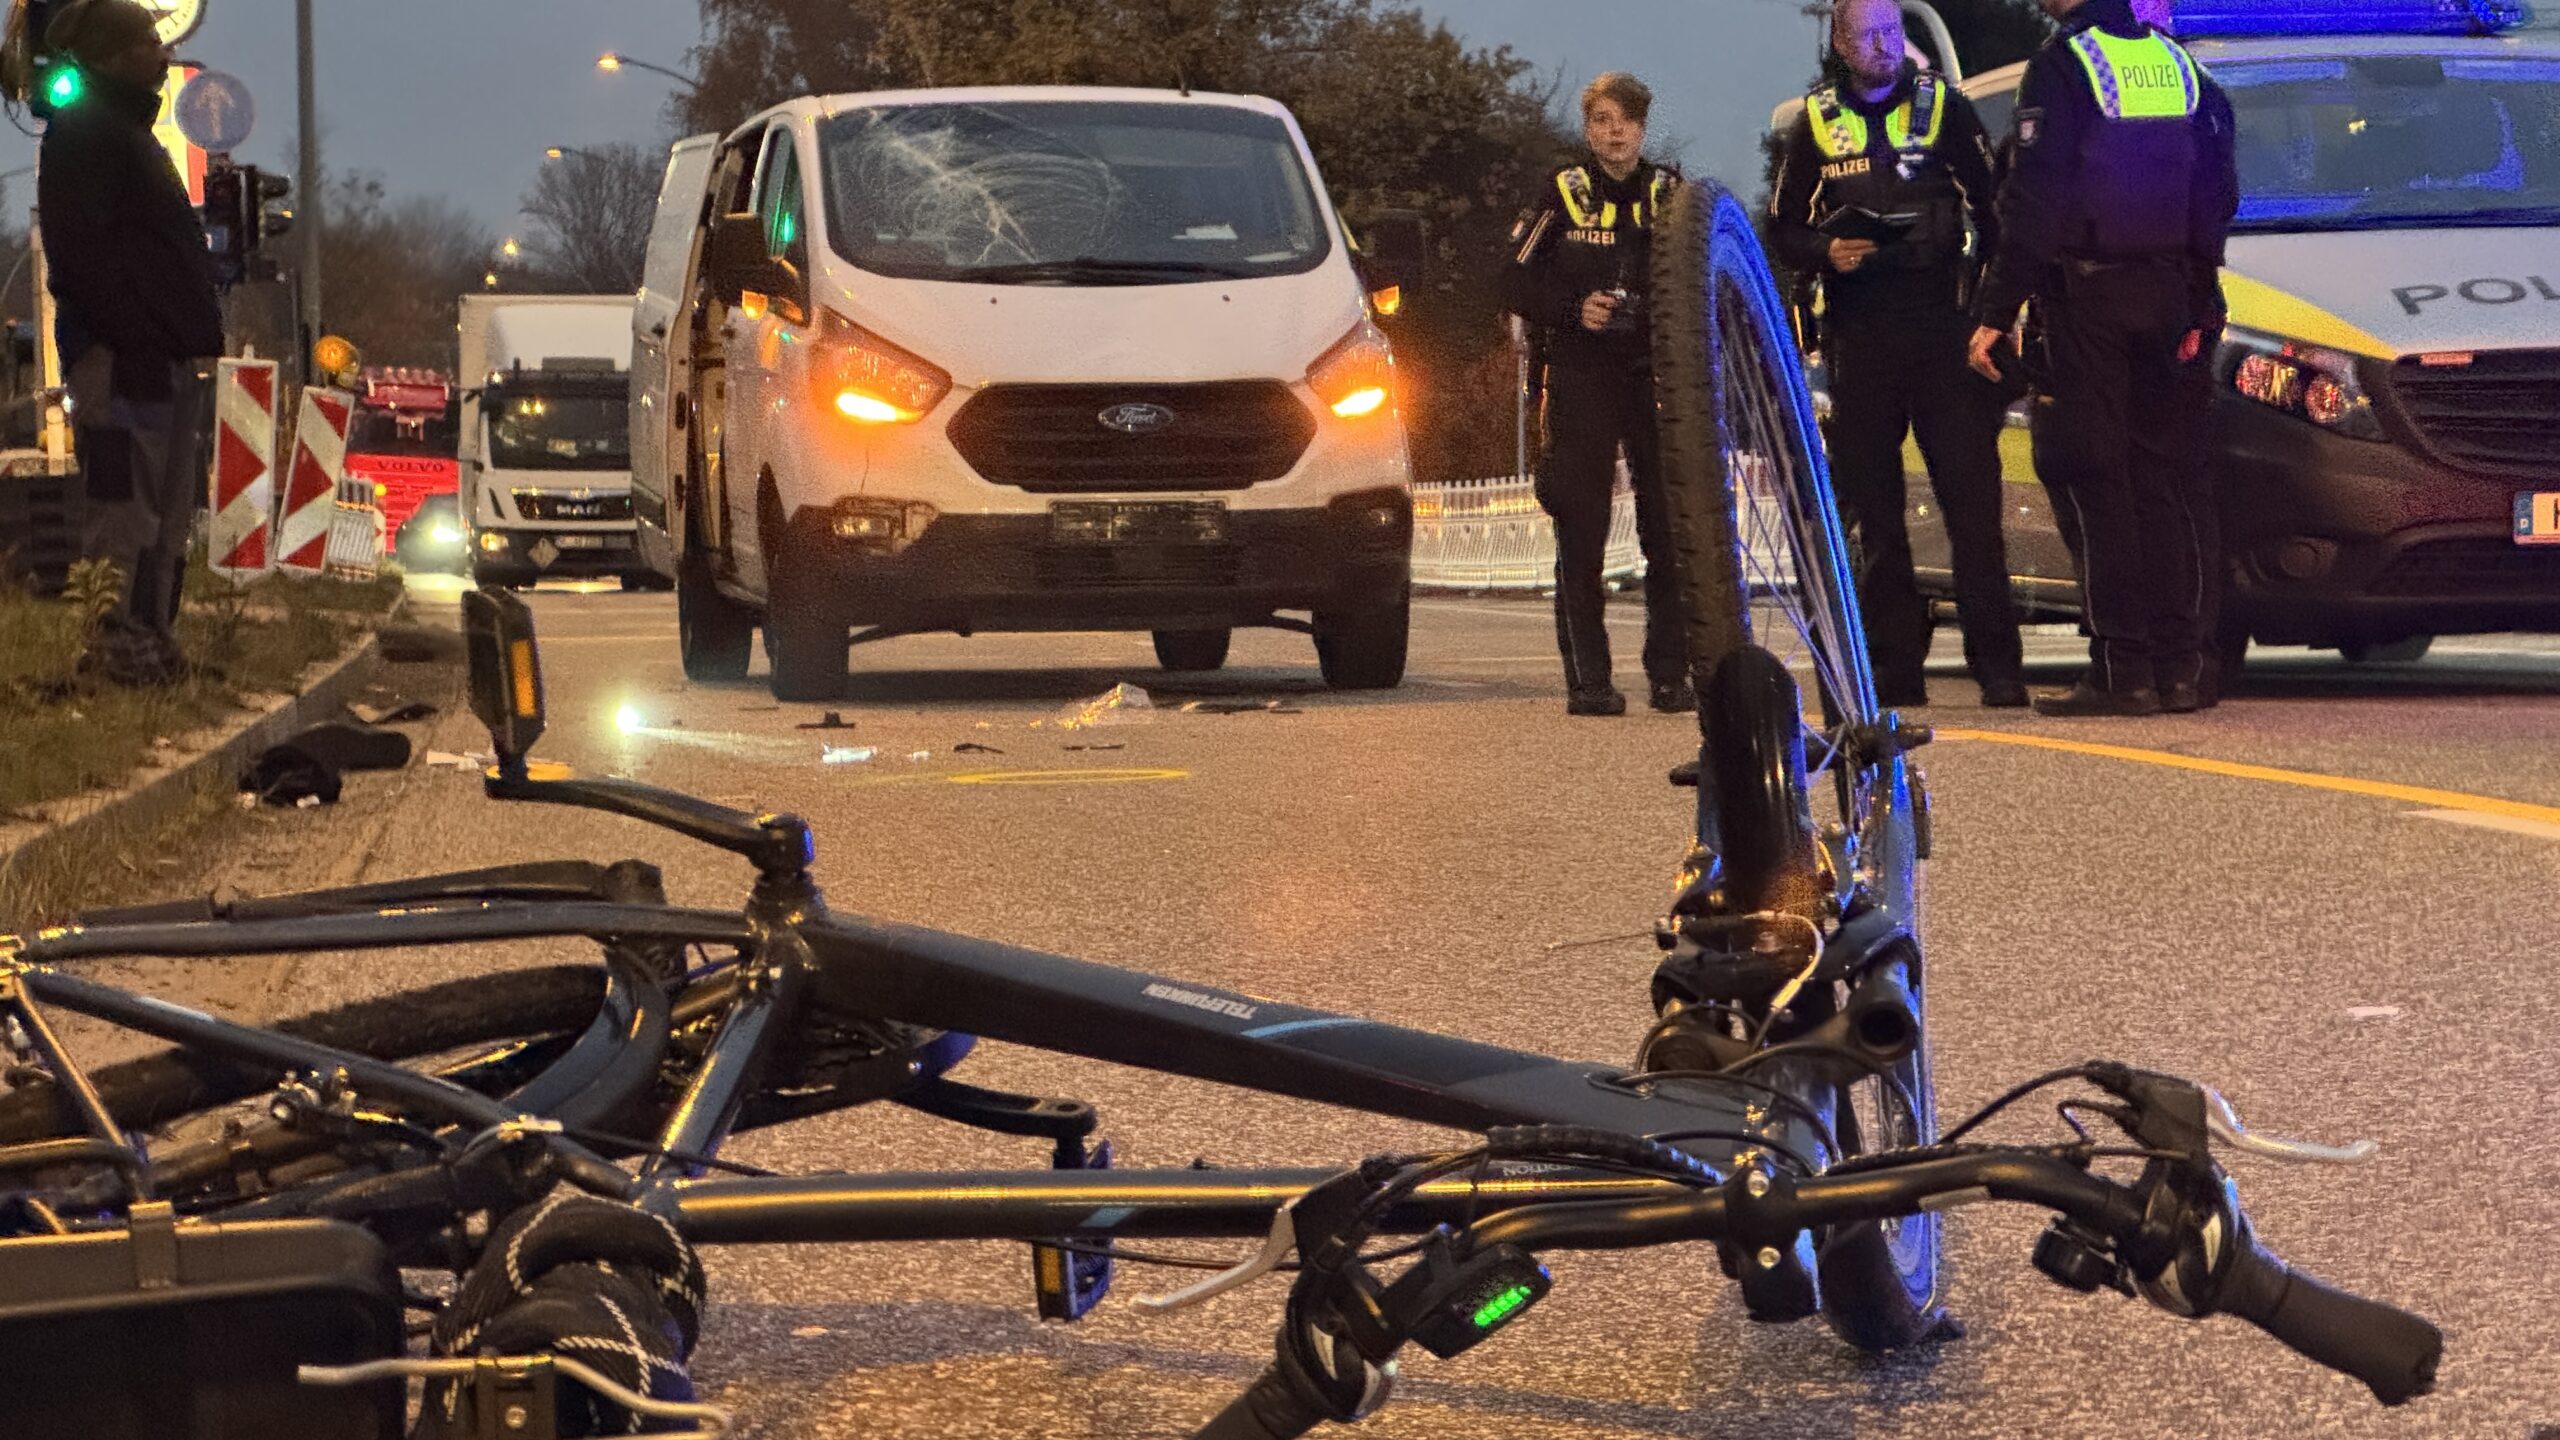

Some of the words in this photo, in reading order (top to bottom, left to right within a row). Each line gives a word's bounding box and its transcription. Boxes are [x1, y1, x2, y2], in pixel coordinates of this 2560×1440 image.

[2121, 64, 2179, 89] POLIZEI
[1821, 157, 1870, 179] POLIZEI
[2391, 275, 2560, 315] POL
[1115, 407, 1157, 425] Ford
[378, 460, 444, 473] VOLVO
[556, 503, 601, 516] MAN
